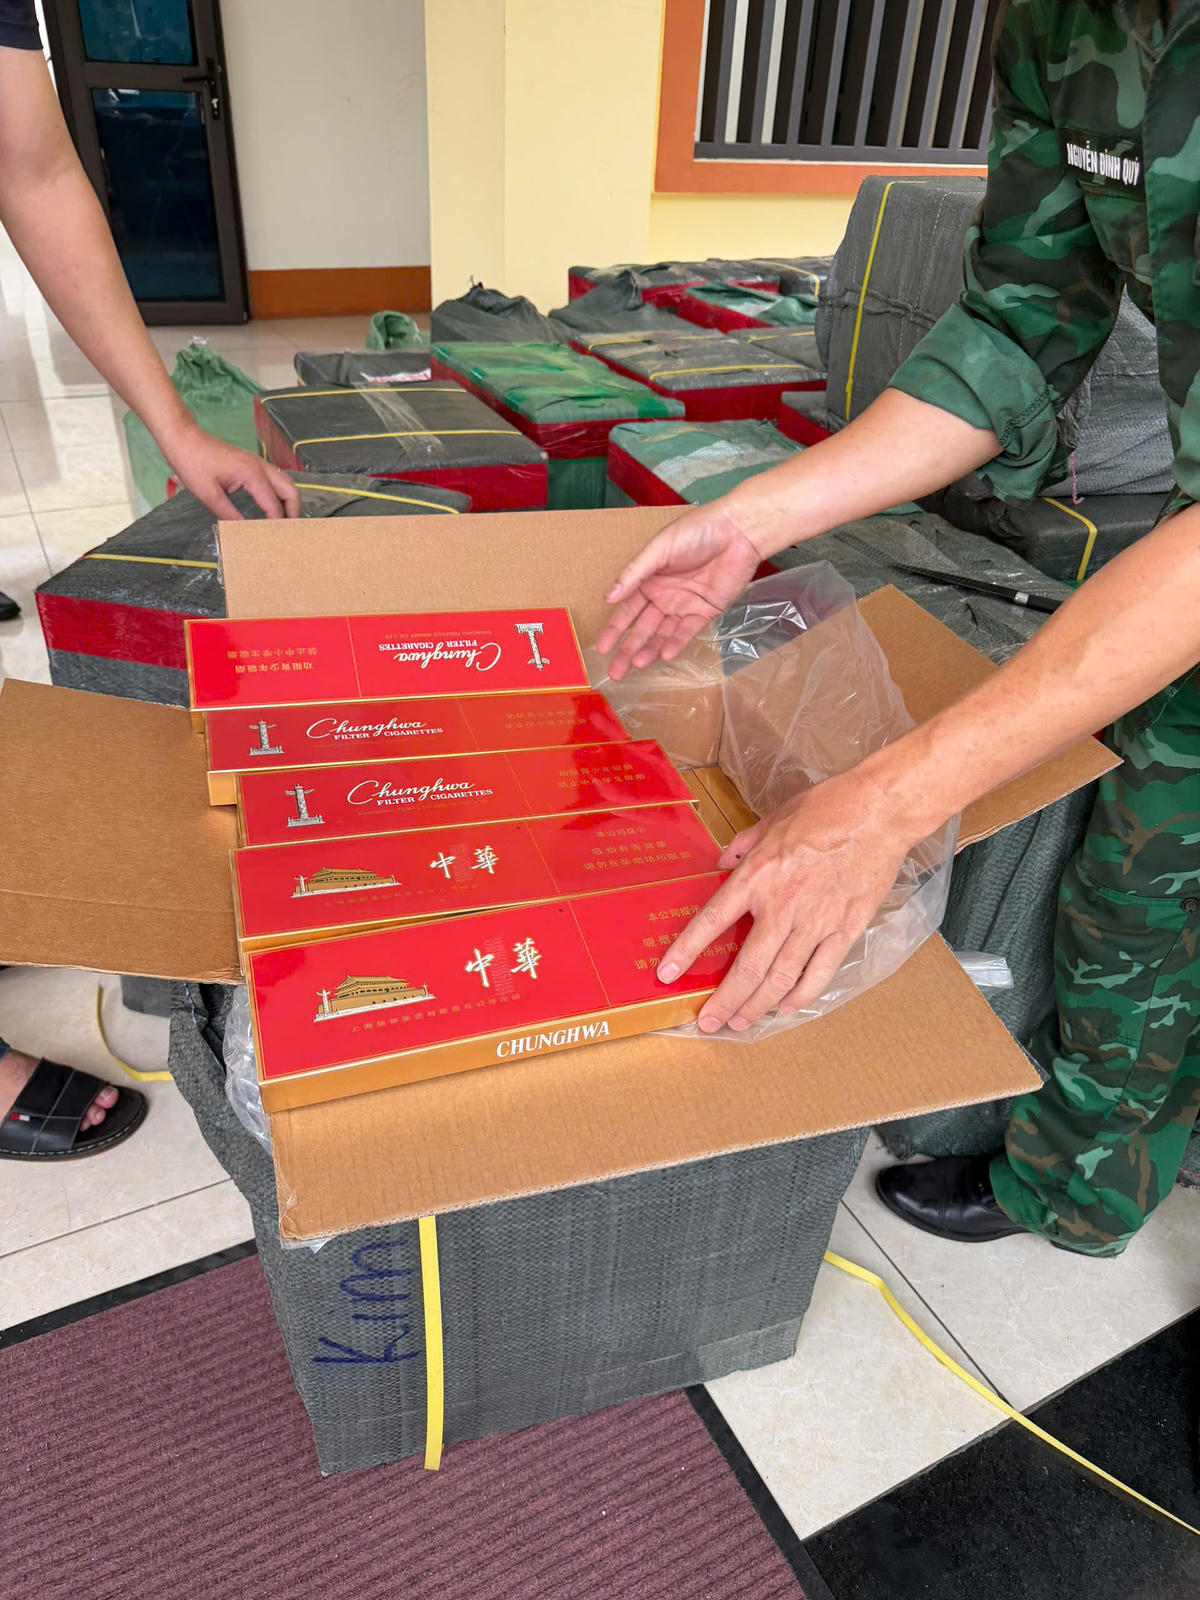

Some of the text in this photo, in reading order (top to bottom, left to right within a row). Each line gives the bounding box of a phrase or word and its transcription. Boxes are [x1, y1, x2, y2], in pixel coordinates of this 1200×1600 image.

[378, 639, 478, 651] FILTER CIGARETTES
[393, 641, 501, 671] Chunghwa
[306, 717, 427, 739] Chunghwa
[333, 728, 444, 741] FILTER CIGARETTES
[347, 777, 475, 805] Chunghwa
[377, 788, 494, 806] FILTER CIGARETTES
[496, 1020, 610, 1058] CHUNGHWA
